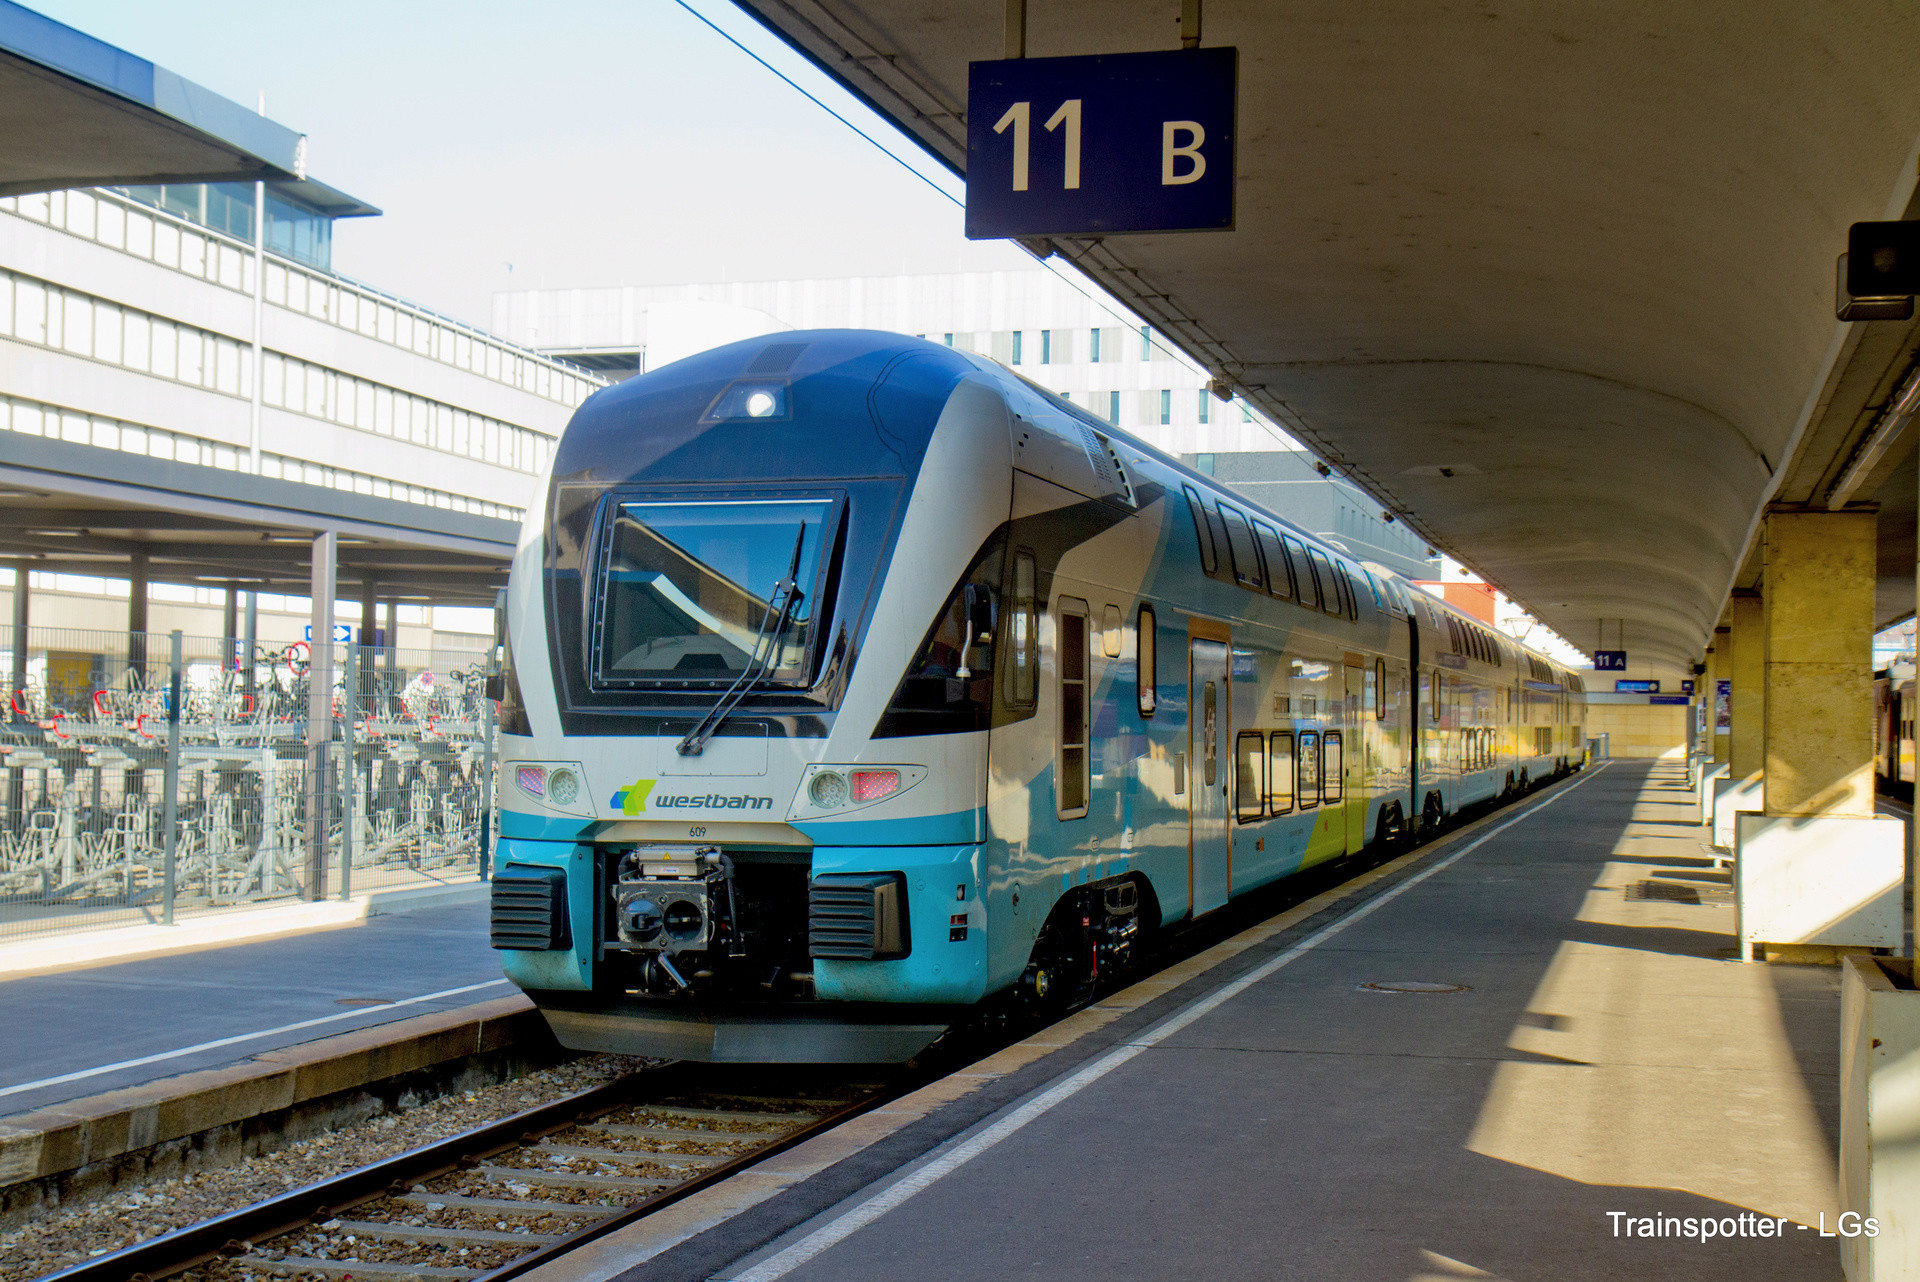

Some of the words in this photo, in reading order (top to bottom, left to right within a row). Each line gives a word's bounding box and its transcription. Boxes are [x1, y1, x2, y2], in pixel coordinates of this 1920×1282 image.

[992, 99, 1082, 192] 11
[1161, 120, 1206, 186] B
[1597, 655, 1609, 666] 11
[1615, 658, 1624, 666] A
[655, 794, 773, 809] westbahn
[689, 827, 706, 837] 609
